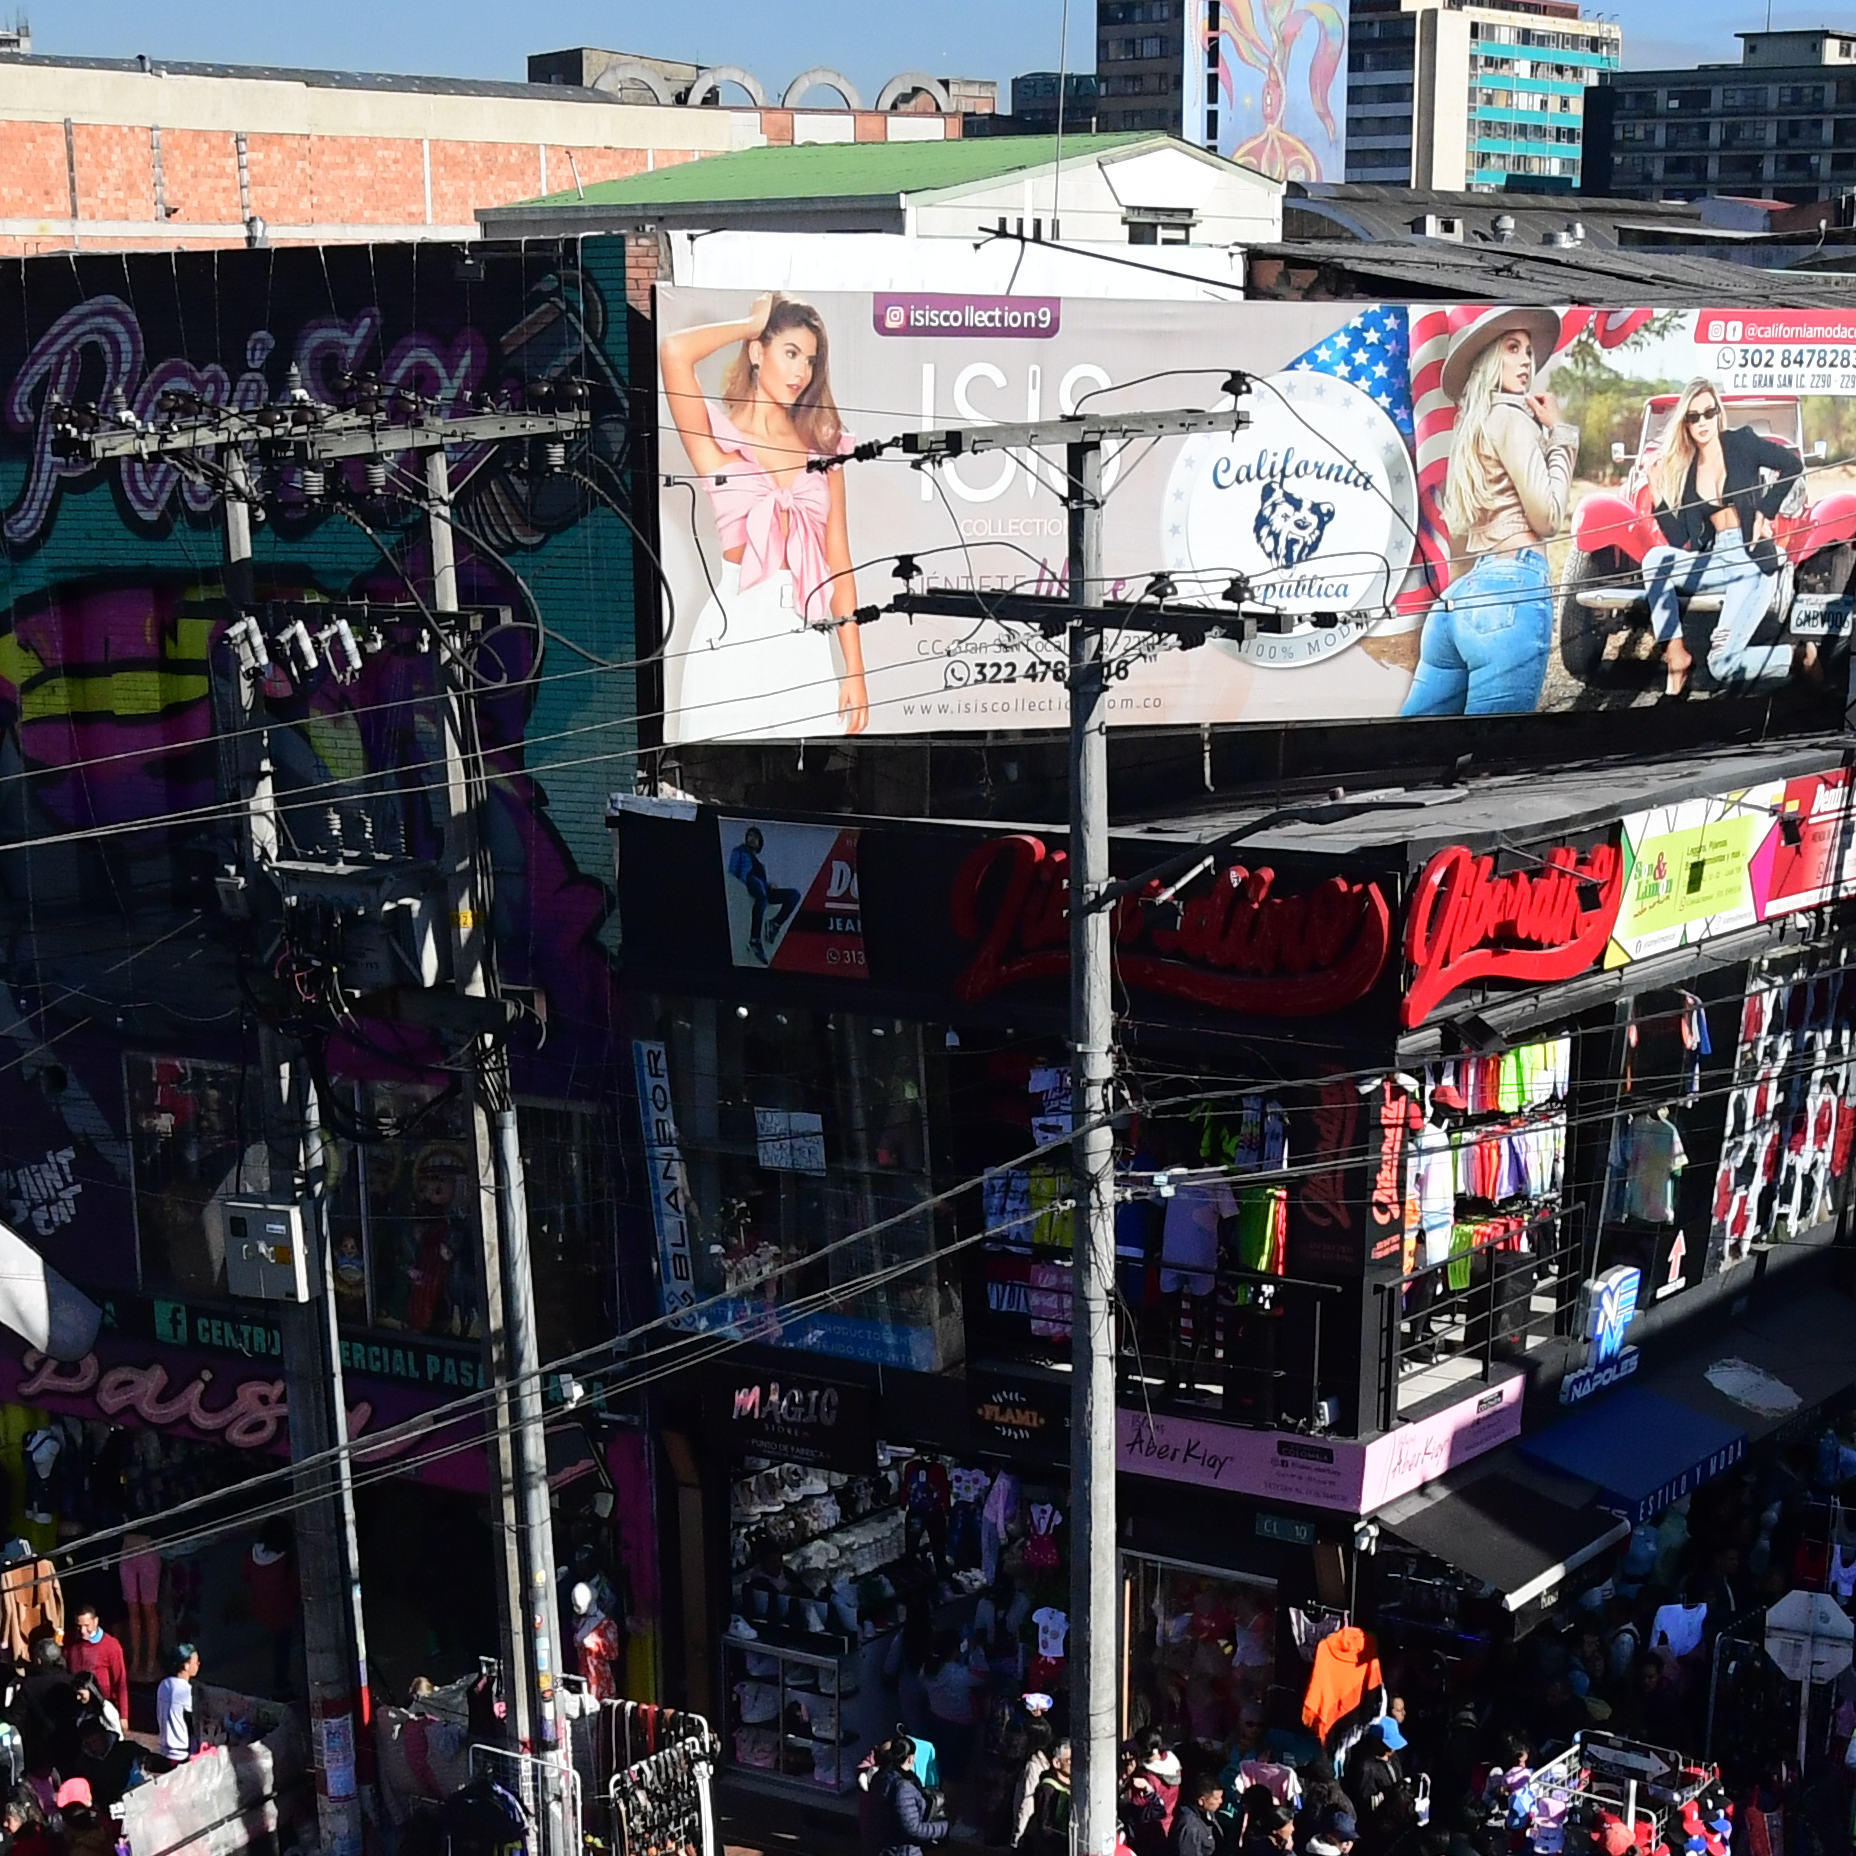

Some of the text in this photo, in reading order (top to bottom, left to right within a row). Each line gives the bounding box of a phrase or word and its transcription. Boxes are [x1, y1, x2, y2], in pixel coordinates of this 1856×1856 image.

[909, 306, 1051, 330] isiscollection9
[1738, 348, 1775, 368] 302
[1752, 373, 1774, 389] GRAN
[1776, 373, 1794, 389] SAN
[1810, 373, 1832, 389] 2290
[1212, 446, 1374, 491] California
[962, 517, 1070, 537] COLLECTIO
[912, 571, 1028, 597] IÉNTETE
[973, 660, 1130, 684] 322 47816
[195, 1315, 284, 1358] CENTRO
[1570, 1354, 1640, 1402] NAPOLES
[731, 1380, 840, 1427] MAGIC
[1639, 1438, 1743, 1522] ESTILO Y MODA
[1294, 1522, 1308, 1539] 10
